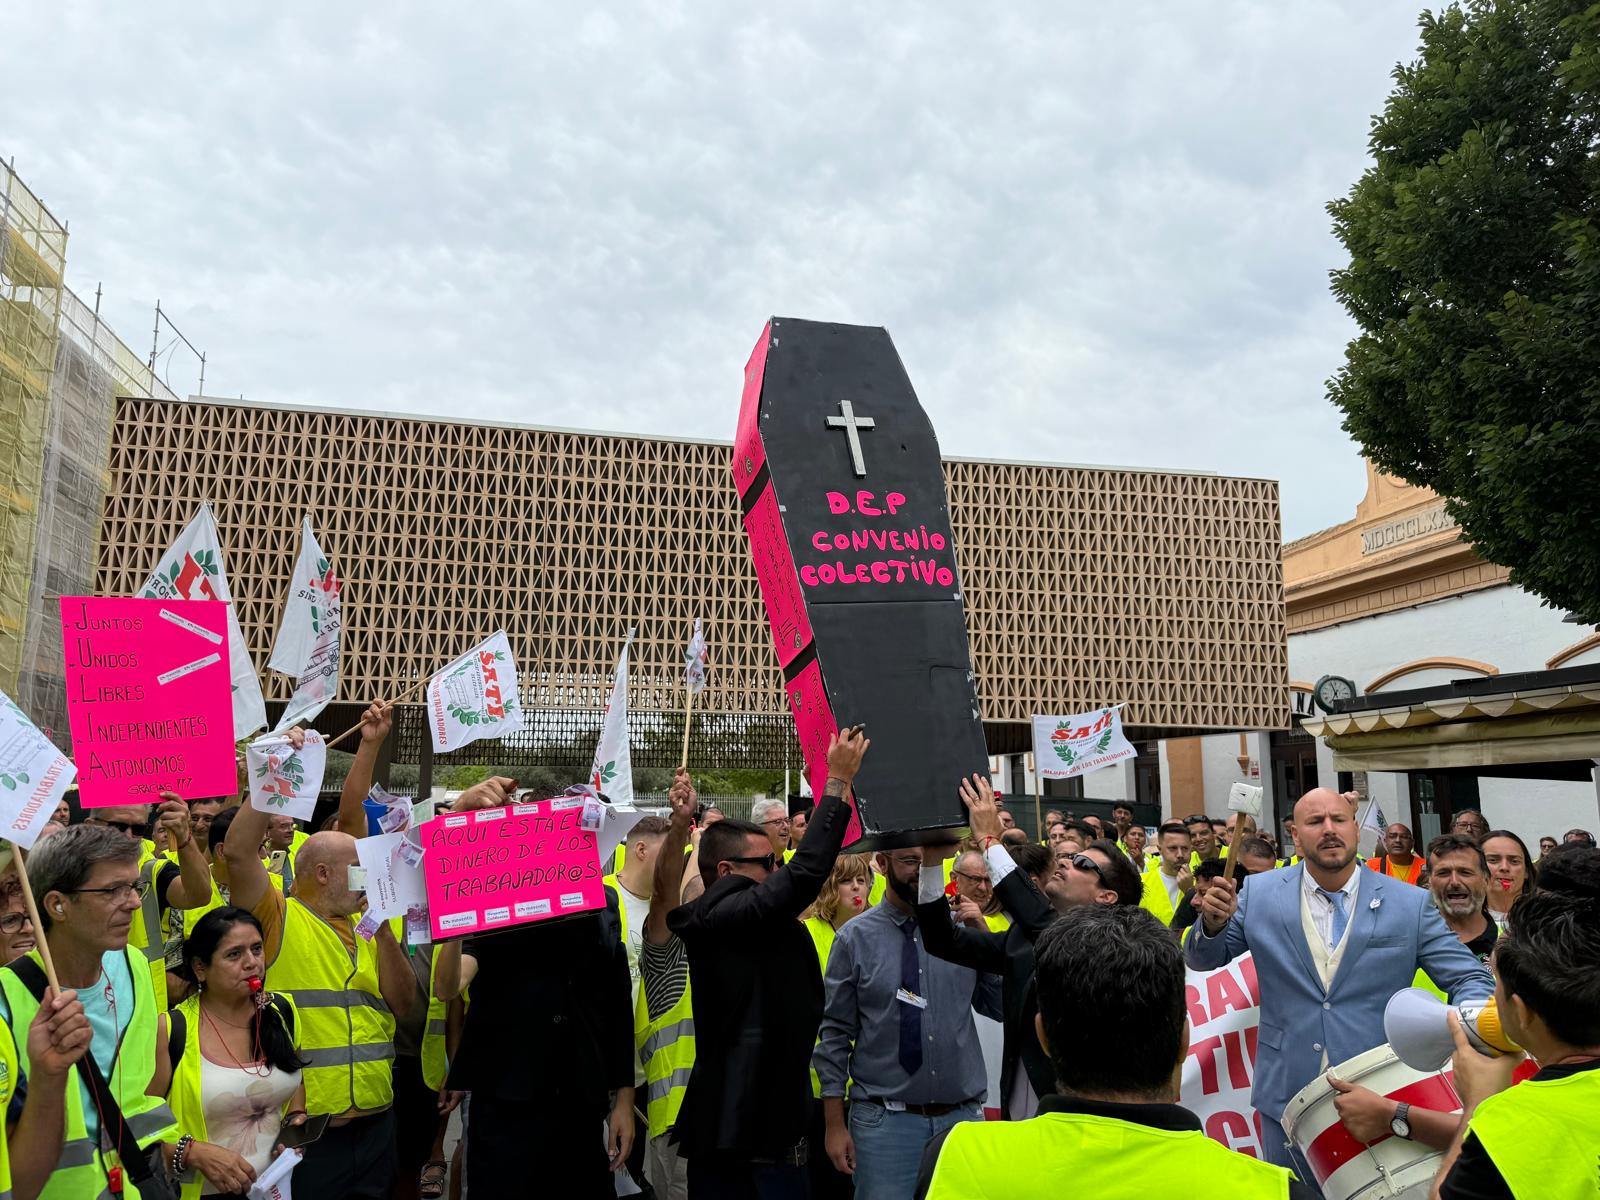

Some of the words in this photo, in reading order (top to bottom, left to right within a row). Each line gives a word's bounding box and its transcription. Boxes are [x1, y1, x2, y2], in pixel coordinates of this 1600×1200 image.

[825, 490, 907, 516] D.E.P
[812, 525, 946, 552] CONVENIO
[1364, 511, 1449, 552] MDCCCLXX
[800, 555, 954, 586] COLECTIVO
[76, 602, 143, 632] JUNTOS
[77, 637, 138, 669] UNIDOS
[80, 674, 145, 703] LIBRES
[479, 650, 505, 719] SATI
[87, 712, 208, 742] INDEPENDIENTES
[88, 750, 187, 781] AUTONOMOS
[127, 781, 173, 795] GRACIAS
[499, 810, 556, 838] ESTÁ
[440, 846, 510, 875] DINERO
[515, 838, 546, 859] DE
[556, 833, 593, 852] LOS
[441, 860, 599, 901] TRABAJADOR@S
